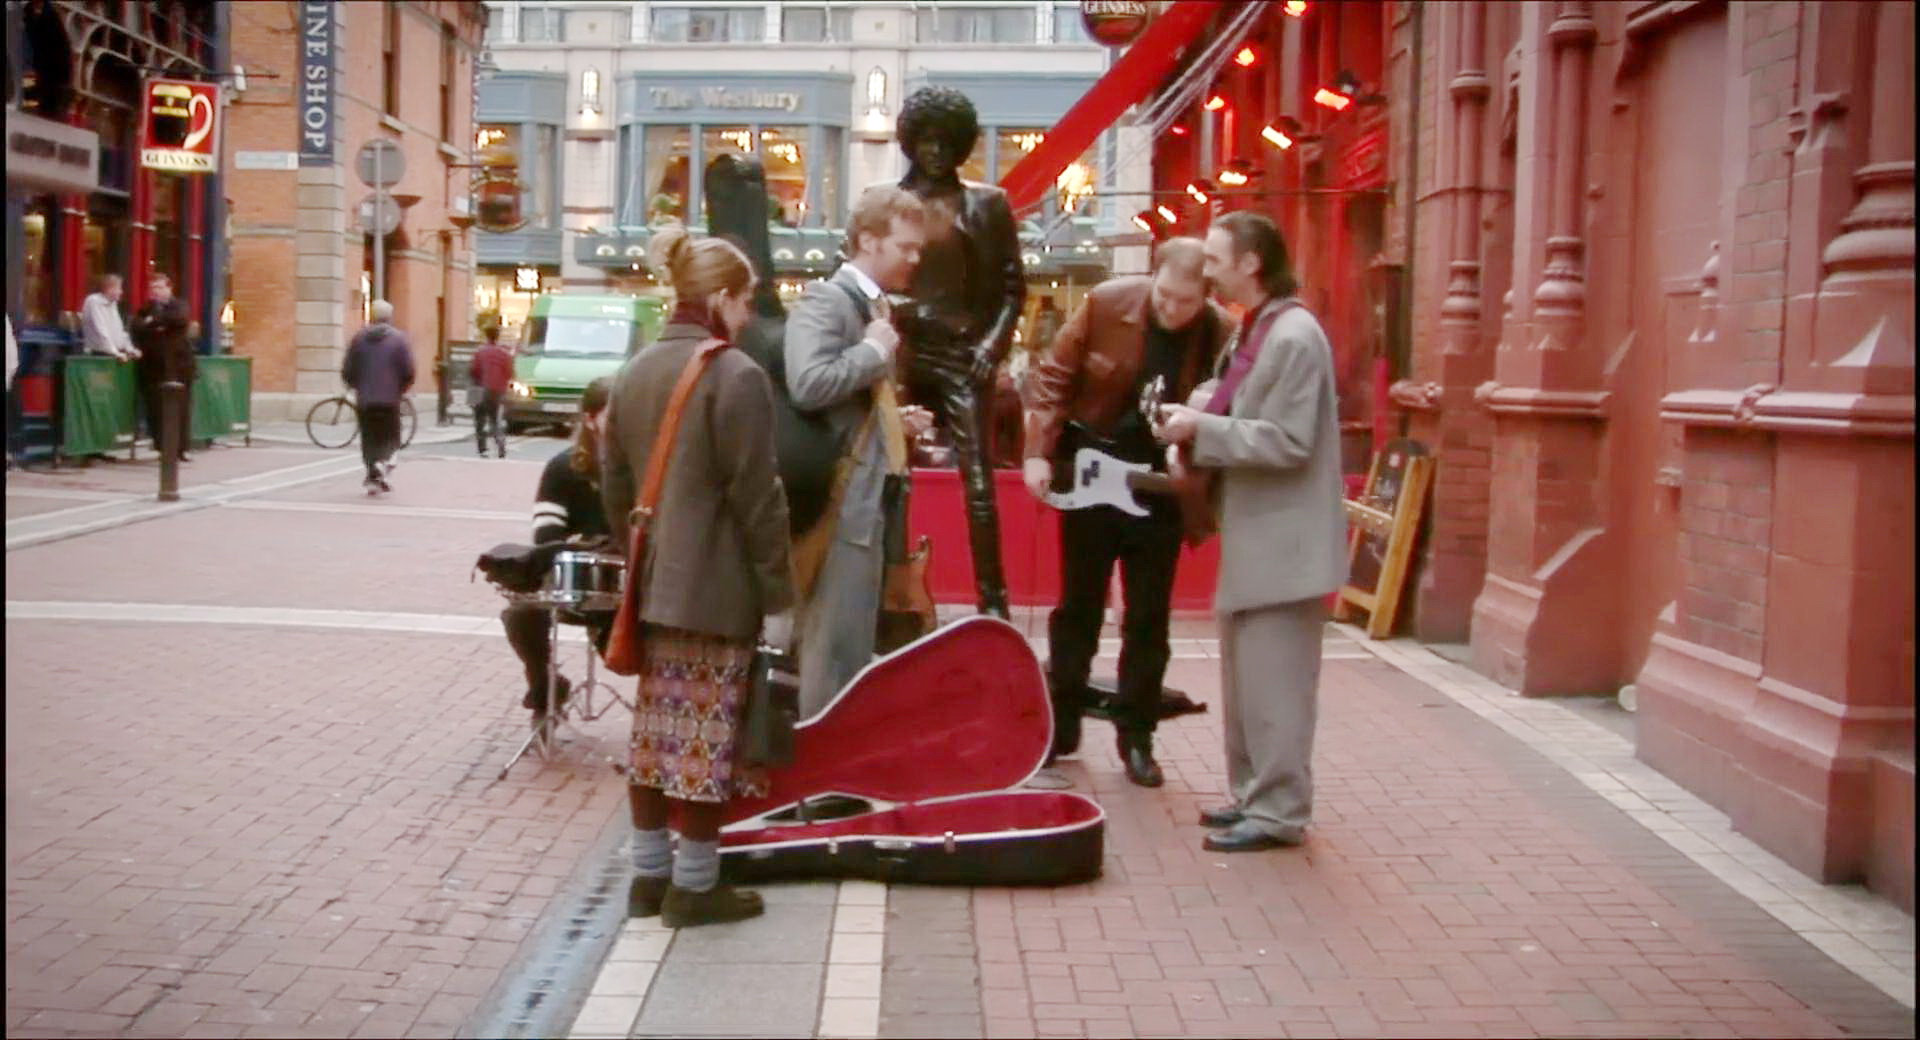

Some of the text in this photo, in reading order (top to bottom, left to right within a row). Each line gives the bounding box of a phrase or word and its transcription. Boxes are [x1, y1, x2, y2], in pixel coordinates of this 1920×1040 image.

[1083, 1, 1146, 15] GUINNESS
[304, 64, 328, 149] SHOP
[650, 85, 800, 113] The Westbury
[146, 152, 209, 167] GUINNESS
